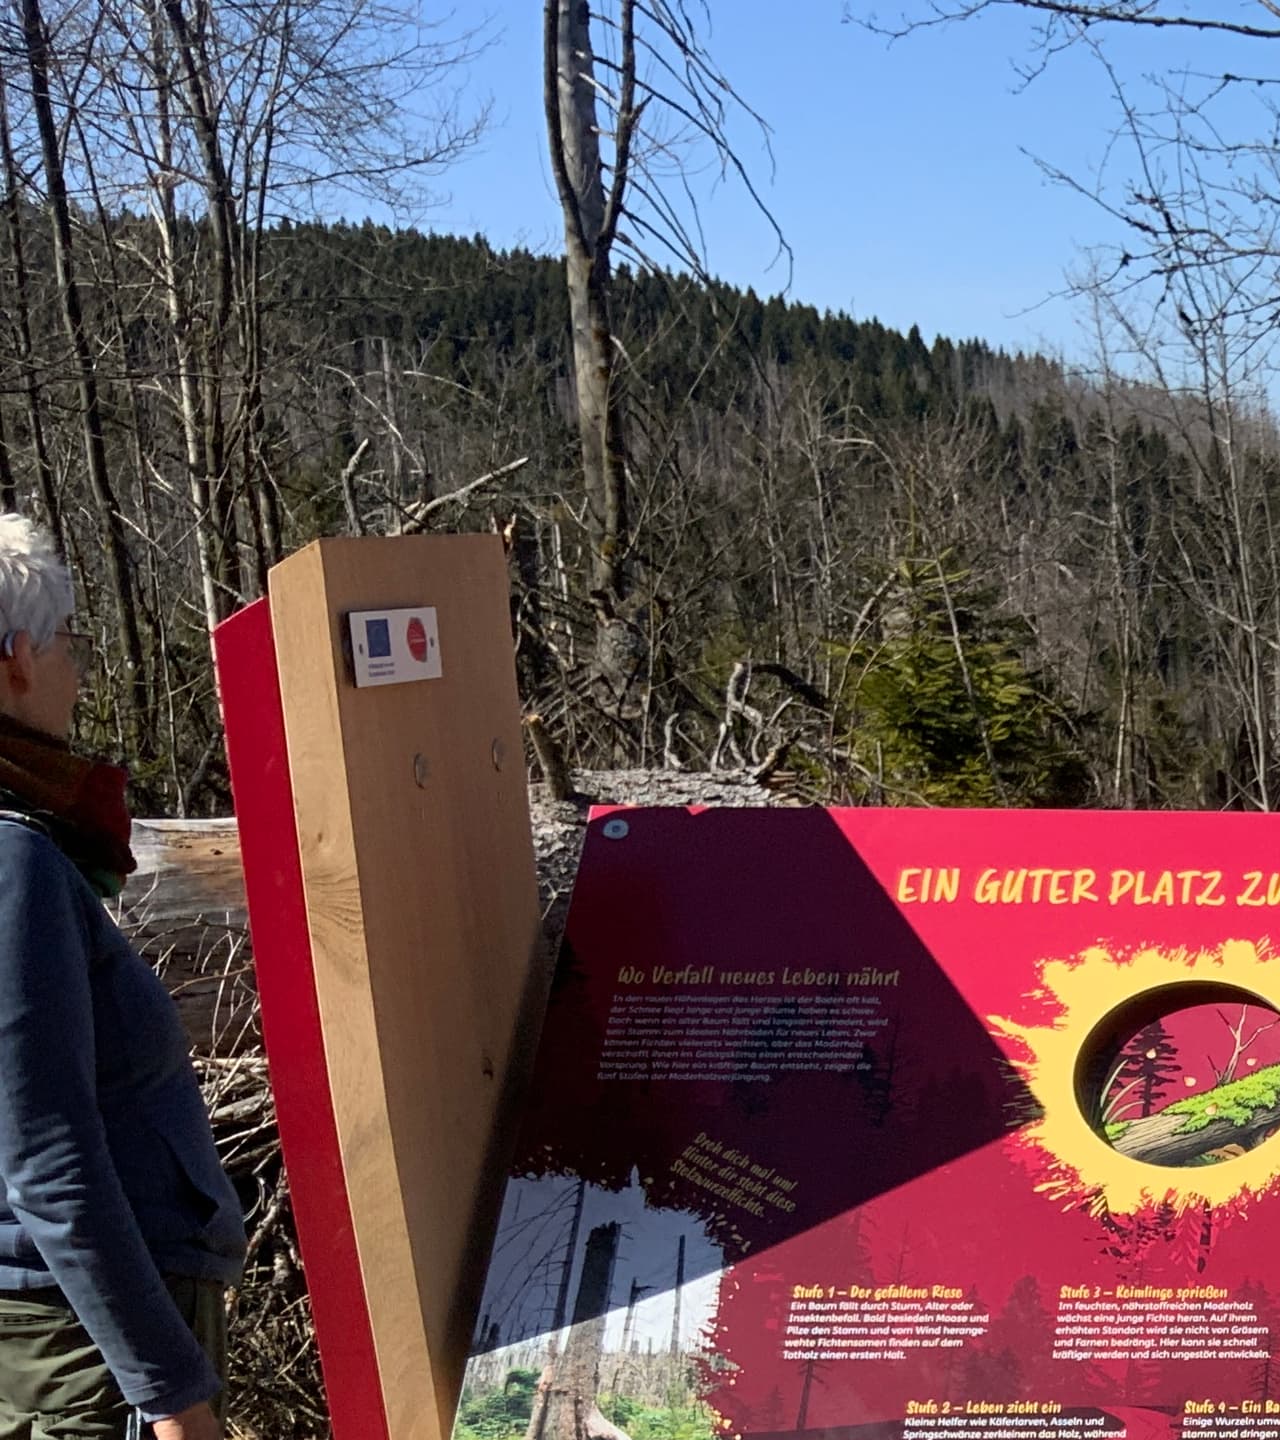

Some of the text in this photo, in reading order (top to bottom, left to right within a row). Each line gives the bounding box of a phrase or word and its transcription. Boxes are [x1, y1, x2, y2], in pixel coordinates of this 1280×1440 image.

[897, 868, 960, 903] EIN
[974, 869, 1098, 904] GUTER
[1108, 870, 1226, 905] PLATZ
[618, 965, 900, 986] Wo Verfall neues Leben nährt
[694, 1132, 799, 1192] Dreh dich mal um!
[682, 1145, 797, 1212] Hinter dir steht diese
[670, 1158, 765, 1218] Stelzwurzelfichte.
[793, 1284, 824, 1298] Stufe
[828, 1286, 835, 1298] 1
[850, 1285, 872, 1298] Der
[874, 1285, 928, 1300] gefallene
[932, 1285, 963, 1299] Riese
[1060, 1284, 1090, 1299] Stufe
[1093, 1286, 1101, 1298] 3
[1116, 1286, 1174, 1300] Keimlinge
[1176, 1286, 1228, 1301] sprießen
[790, 1300, 974, 1311] Ein Baum fällt durch Sturm, Alter oder
[906, 1400, 938, 1414] Stufe
[941, 1401, 950, 1414] 2
[966, 1401, 1004, 1414] Leben
[1006, 1401, 1038, 1414] zieht
[1041, 1401, 1062, 1414] ein
[1184, 1399, 1215, 1414] Stufe
[1218, 1402, 1226, 1413] 4
[1242, 1400, 1262, 1413] Ein
[904, 1417, 1105, 1426] Kleine Helfer wie Käferlarven, Asseln und
